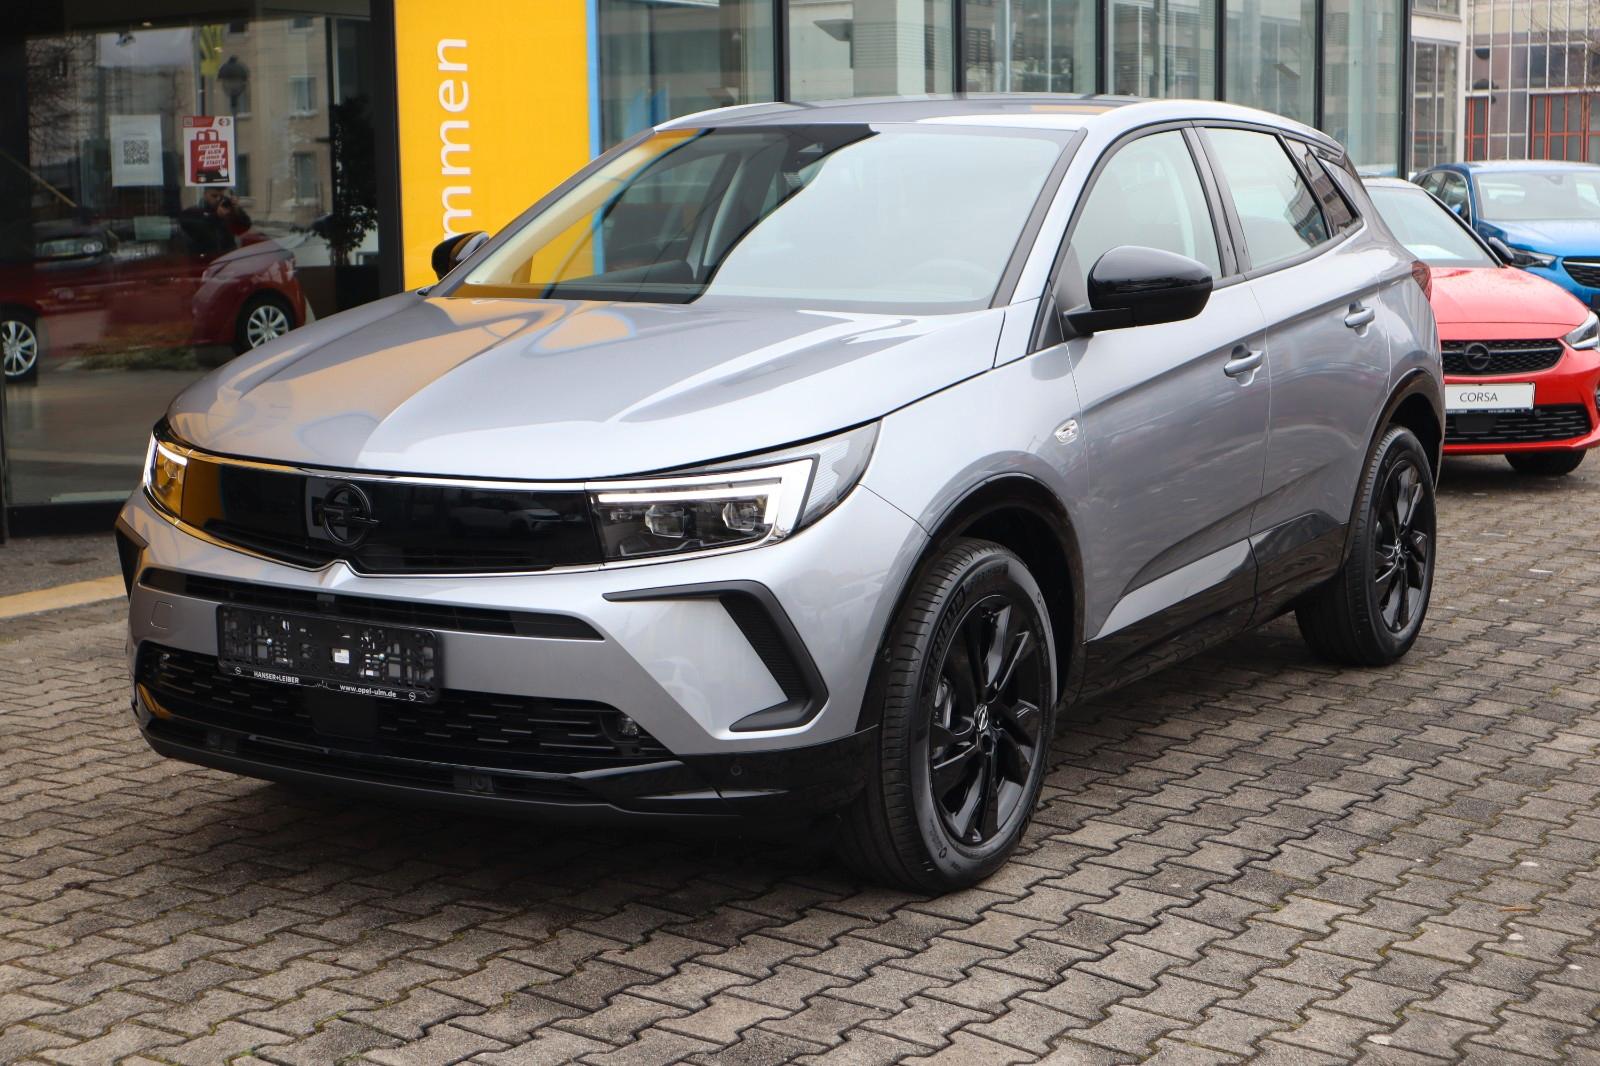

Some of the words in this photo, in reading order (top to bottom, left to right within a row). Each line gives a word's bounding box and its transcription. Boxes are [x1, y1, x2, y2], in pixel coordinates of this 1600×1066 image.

[1459, 391, 1499, 403] CORSA
[253, 670, 300, 684] HANSER+LEIBER
[339, 683, 397, 699] www.opel-ulm.de
